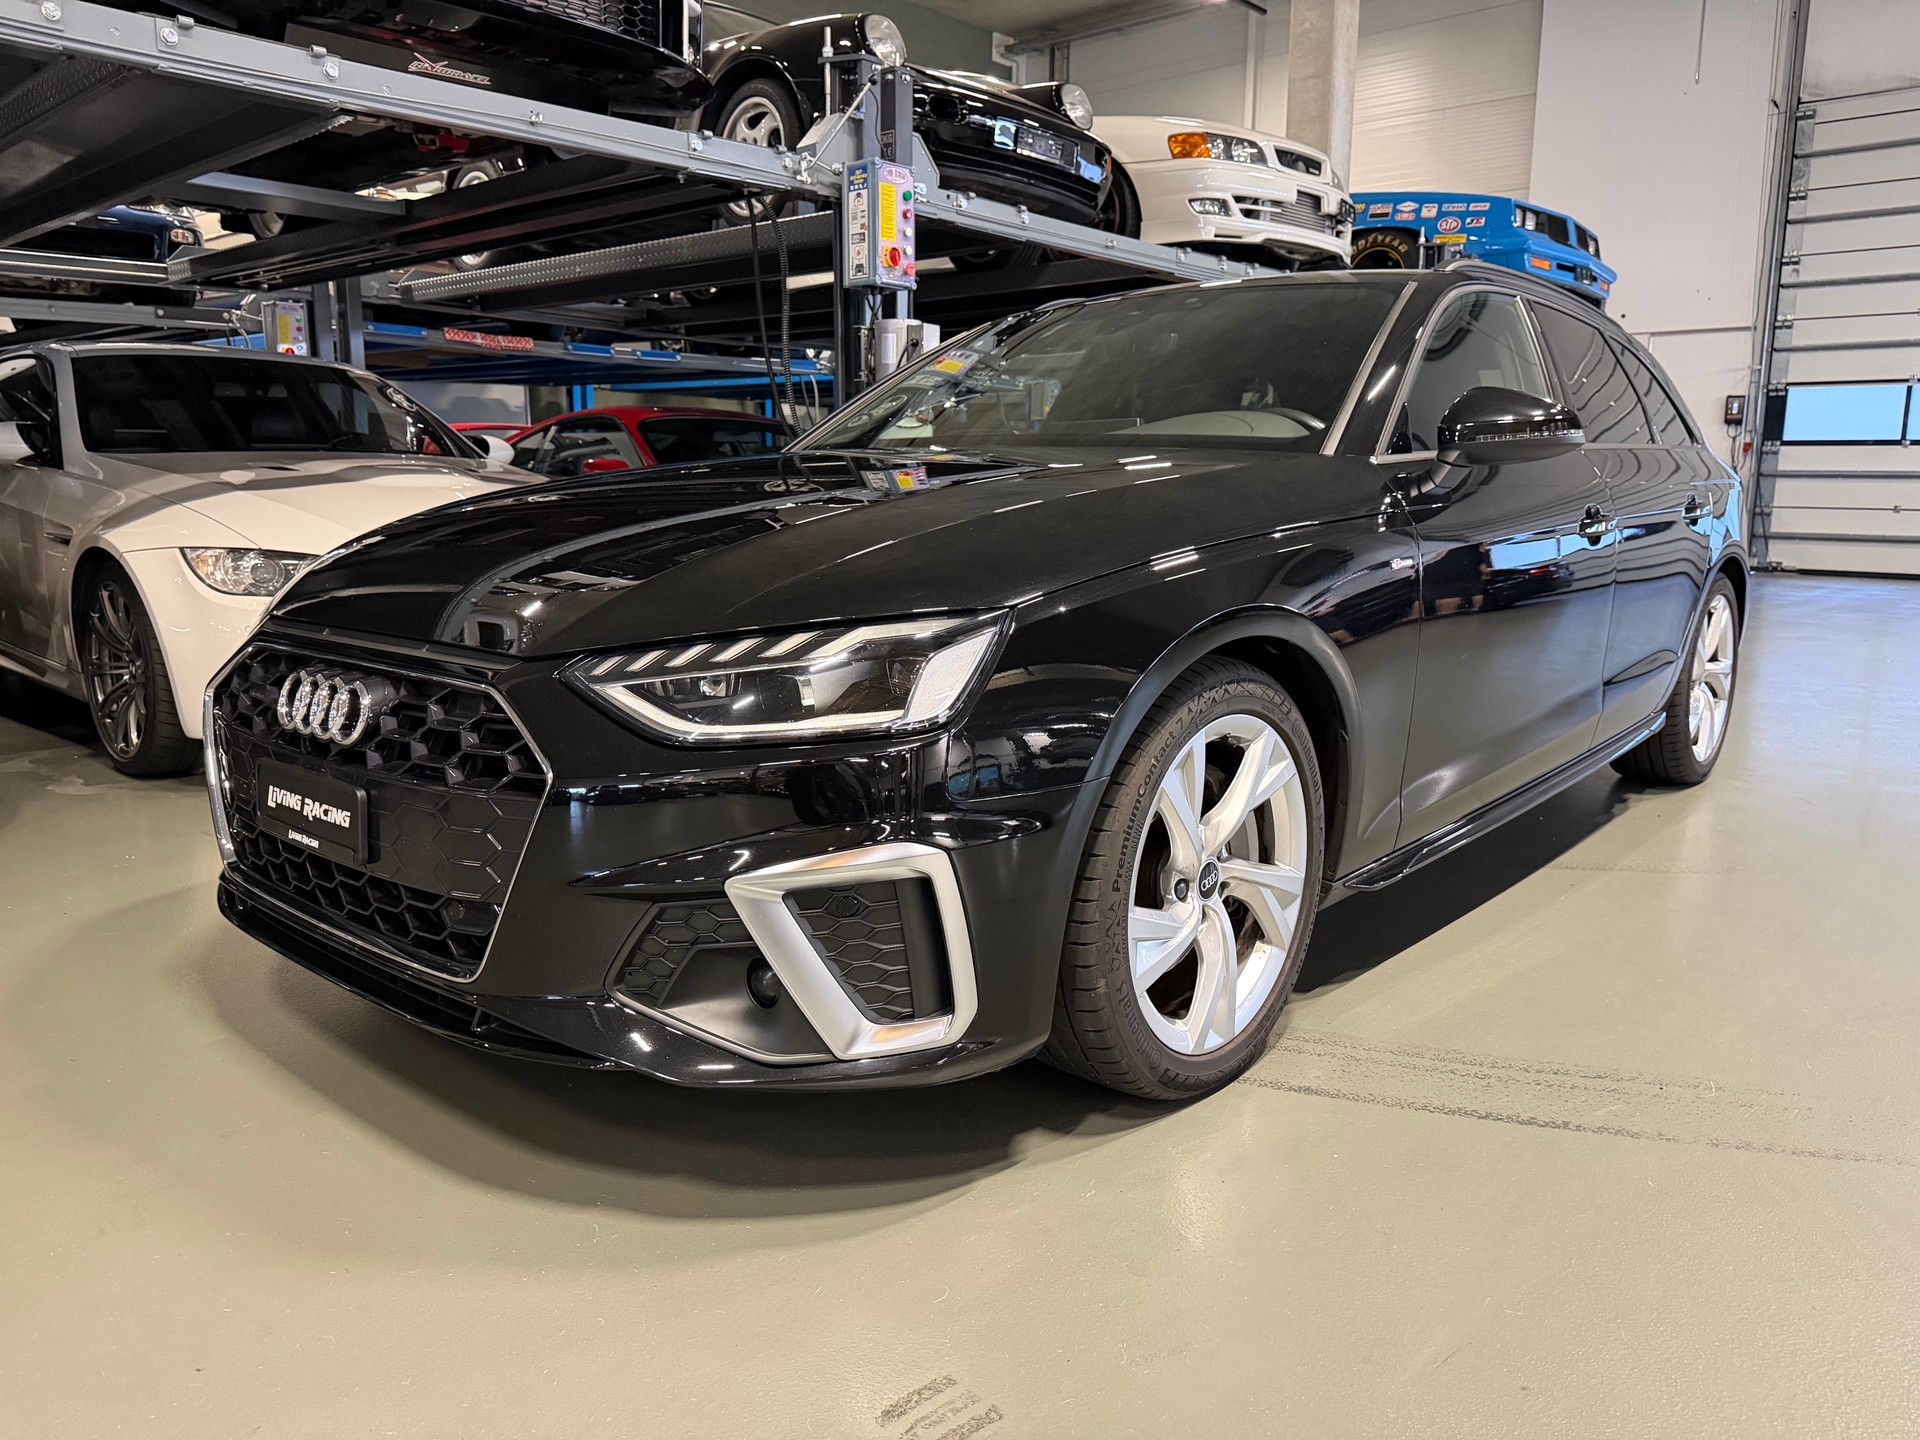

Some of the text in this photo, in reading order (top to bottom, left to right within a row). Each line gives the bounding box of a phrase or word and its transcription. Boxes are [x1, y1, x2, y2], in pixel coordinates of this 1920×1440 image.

[1441, 217, 1458, 231] STP
[1350, 232, 1408, 255] ODYEAR
[1112, 729, 1176, 892] PremiumContact
